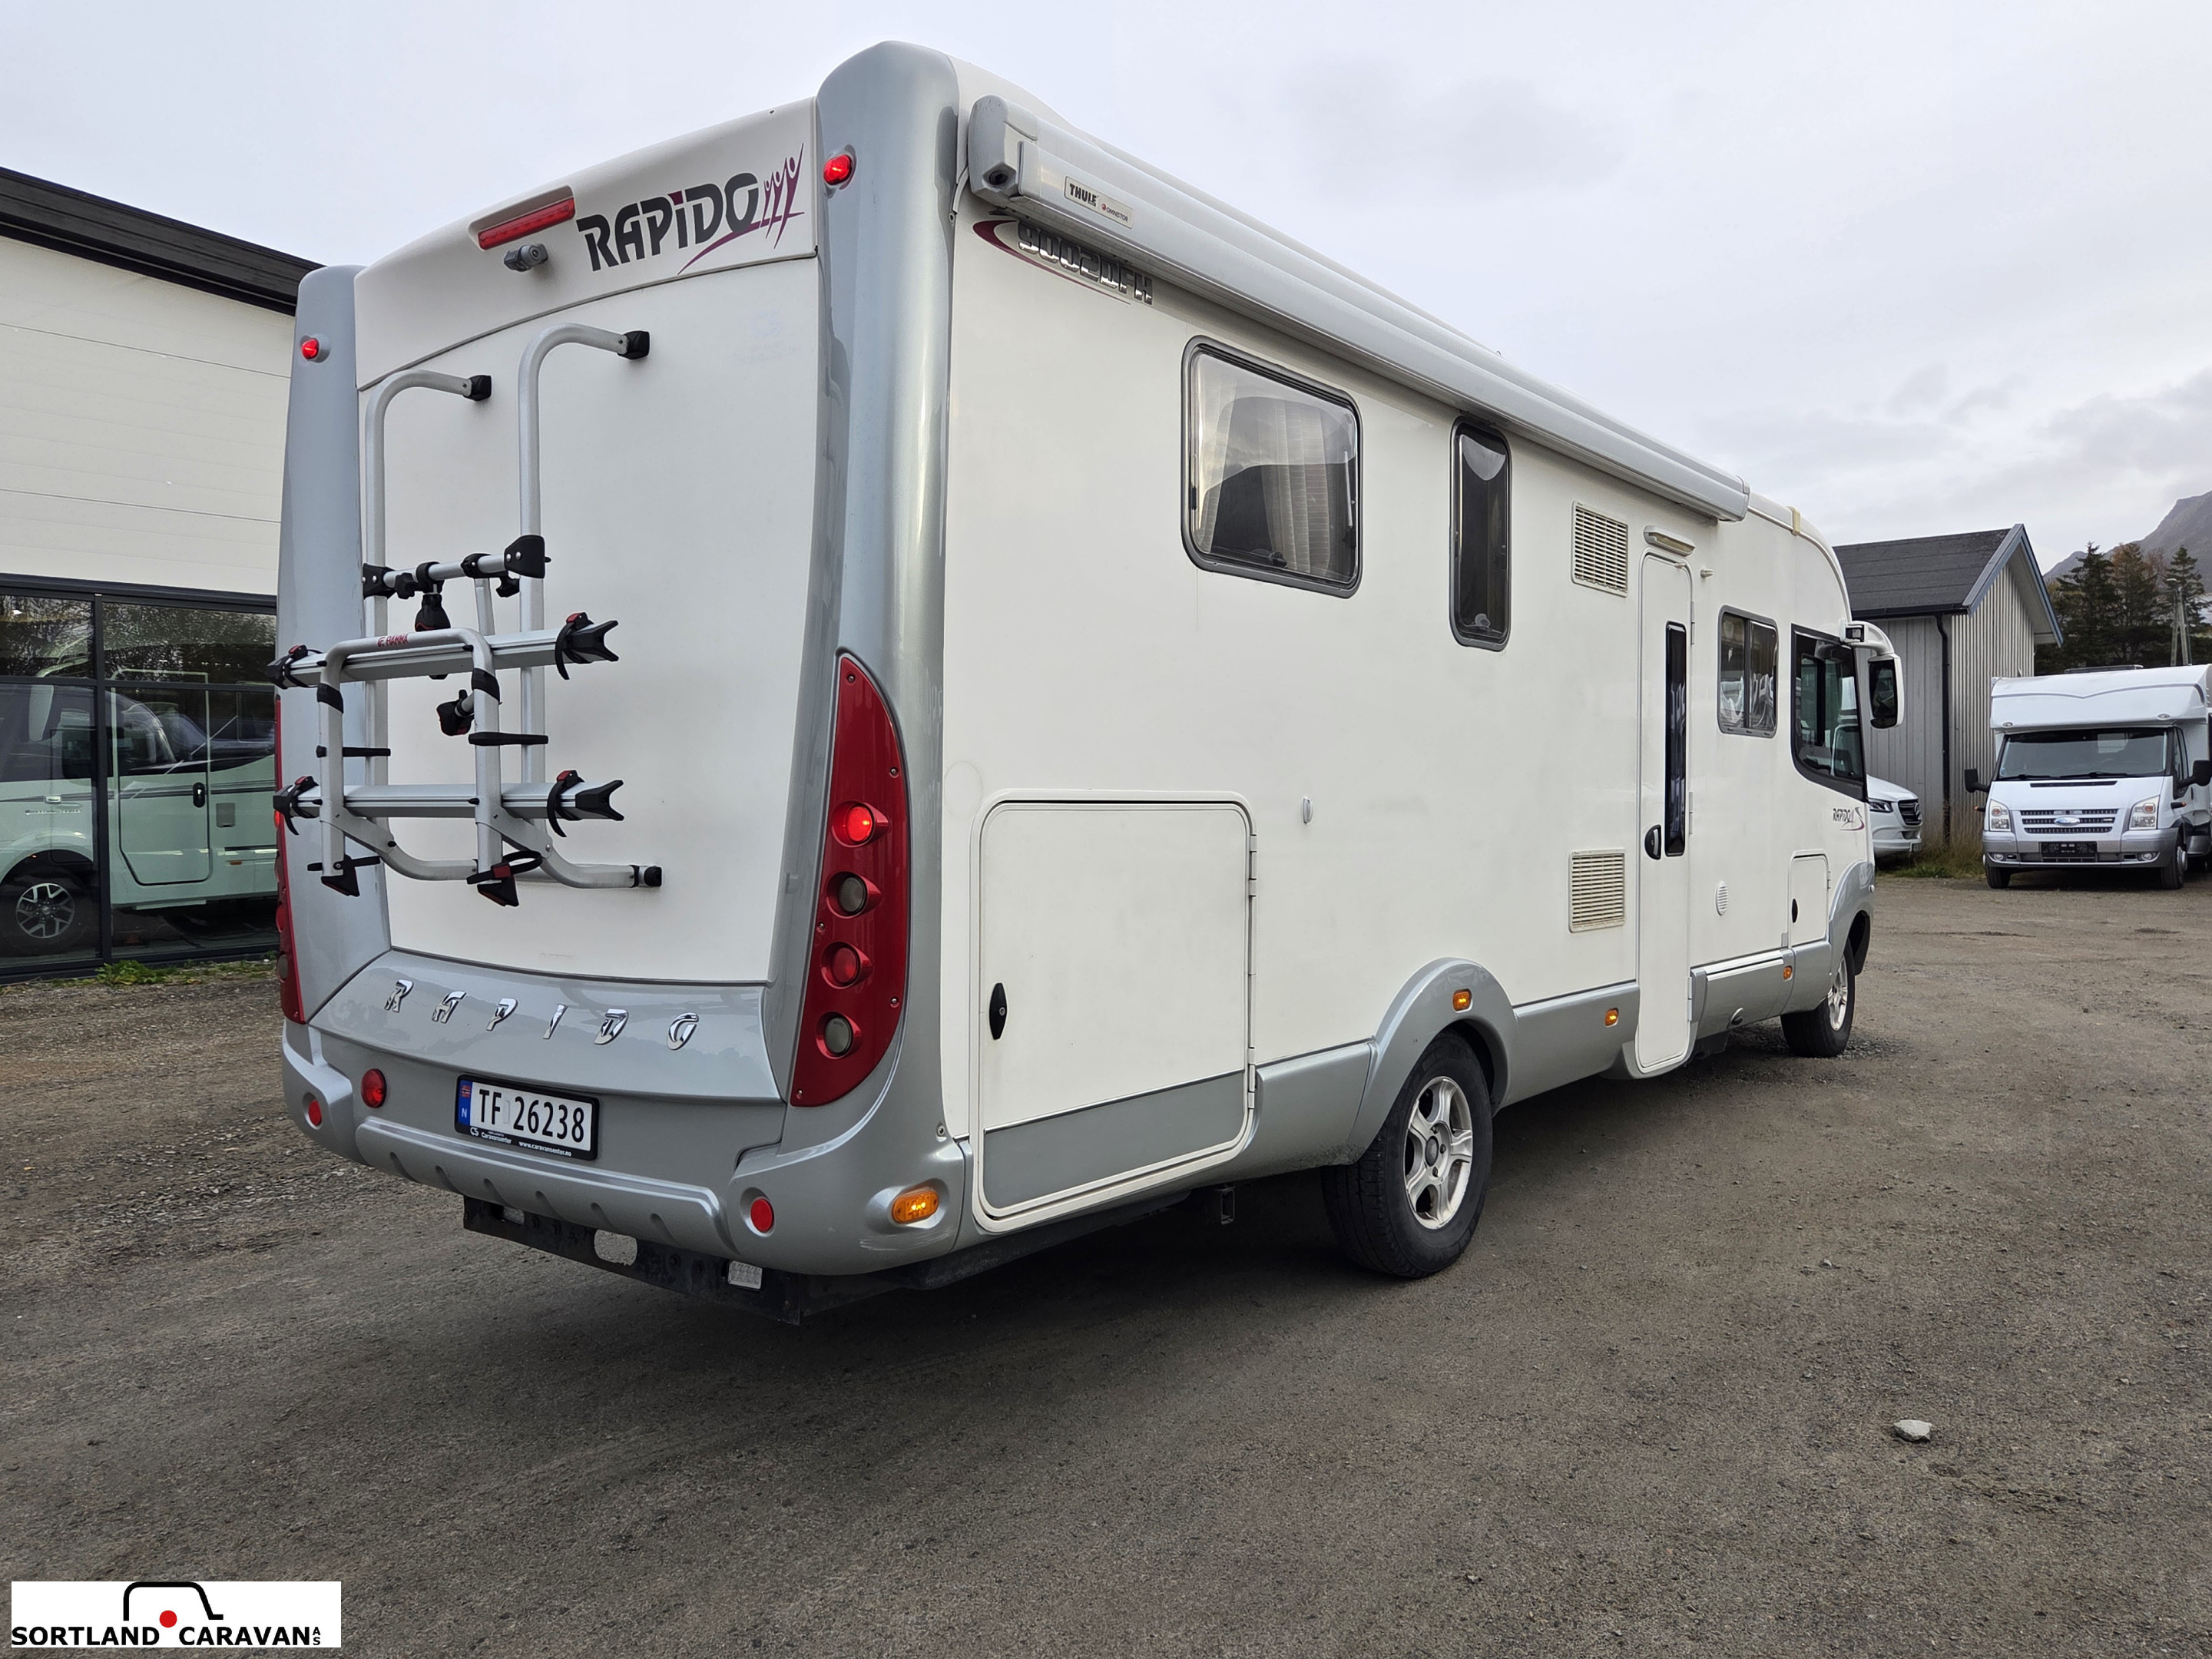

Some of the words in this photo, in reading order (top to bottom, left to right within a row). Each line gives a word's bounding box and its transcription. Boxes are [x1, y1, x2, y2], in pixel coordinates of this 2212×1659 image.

[1069, 183, 1097, 207] THULE
[384, 979, 699, 1050] RAPIDO
[461, 1108, 468, 1118] N
[478, 1088, 502, 1125] TF
[513, 1096, 584, 1143] 26238
